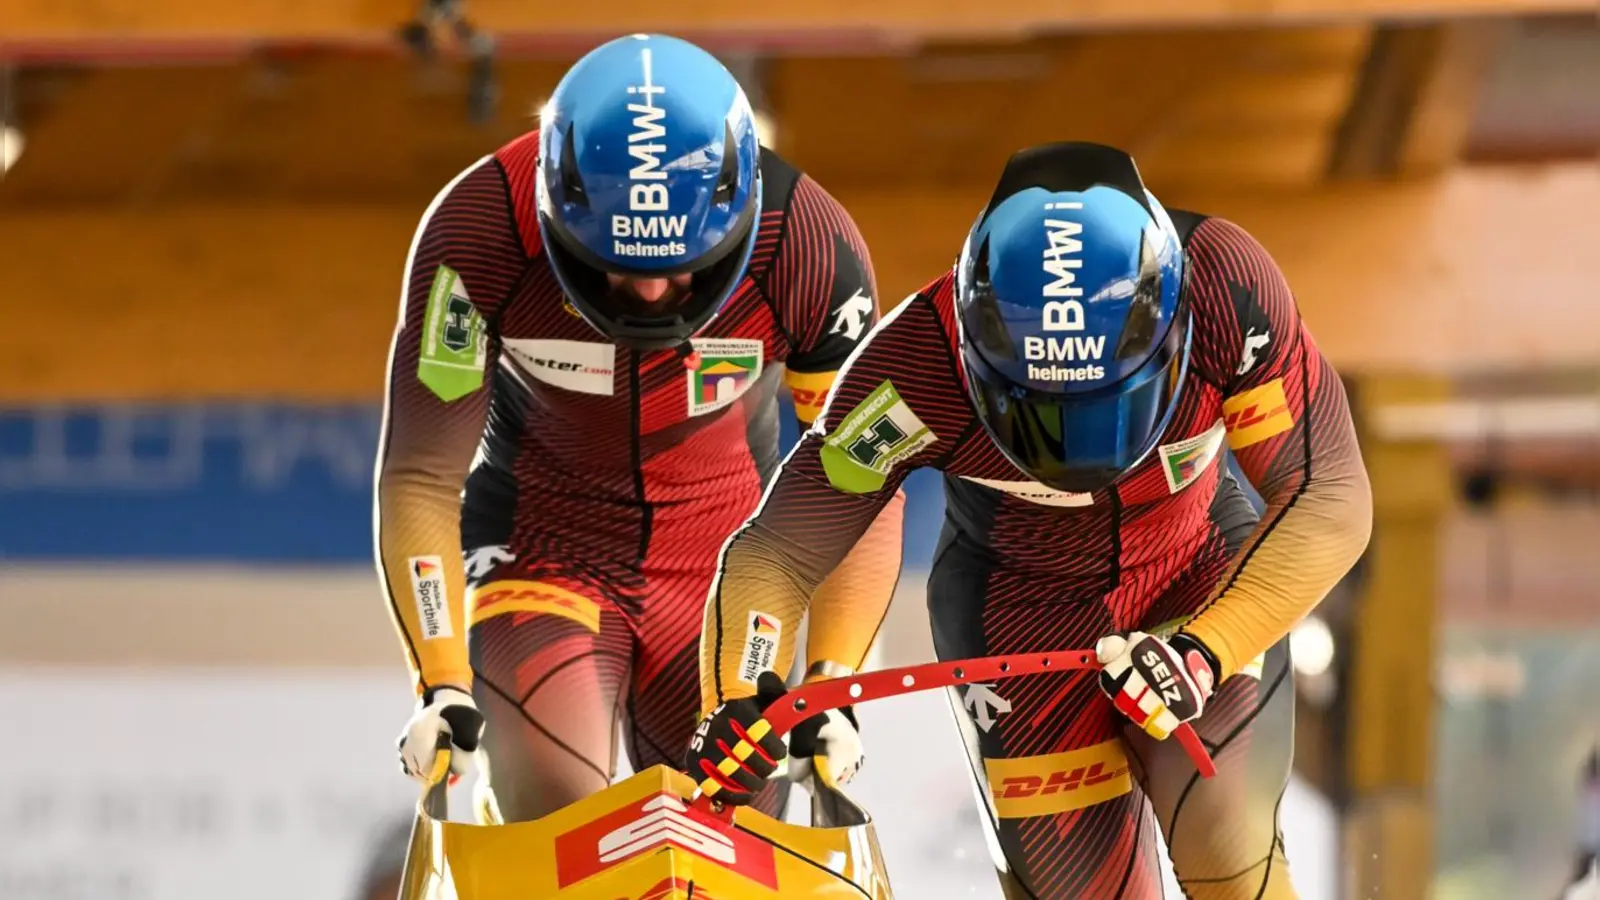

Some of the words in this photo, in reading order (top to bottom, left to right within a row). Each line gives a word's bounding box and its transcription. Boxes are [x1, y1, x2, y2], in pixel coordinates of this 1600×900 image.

[628, 103, 669, 212] BMW
[1044, 201, 1083, 211] i
[611, 214, 688, 239] BMW
[613, 239, 687, 257] helmets
[1042, 218, 1085, 332] BMW
[1023, 335, 1106, 362] BMW
[1027, 363, 1105, 382] helmets
[417, 580, 441, 637] Sporthilfe
[744, 635, 767, 682] Sporthilfe
[1141, 650, 1182, 707] SEIZ
[1001, 761, 1113, 798] DHL
